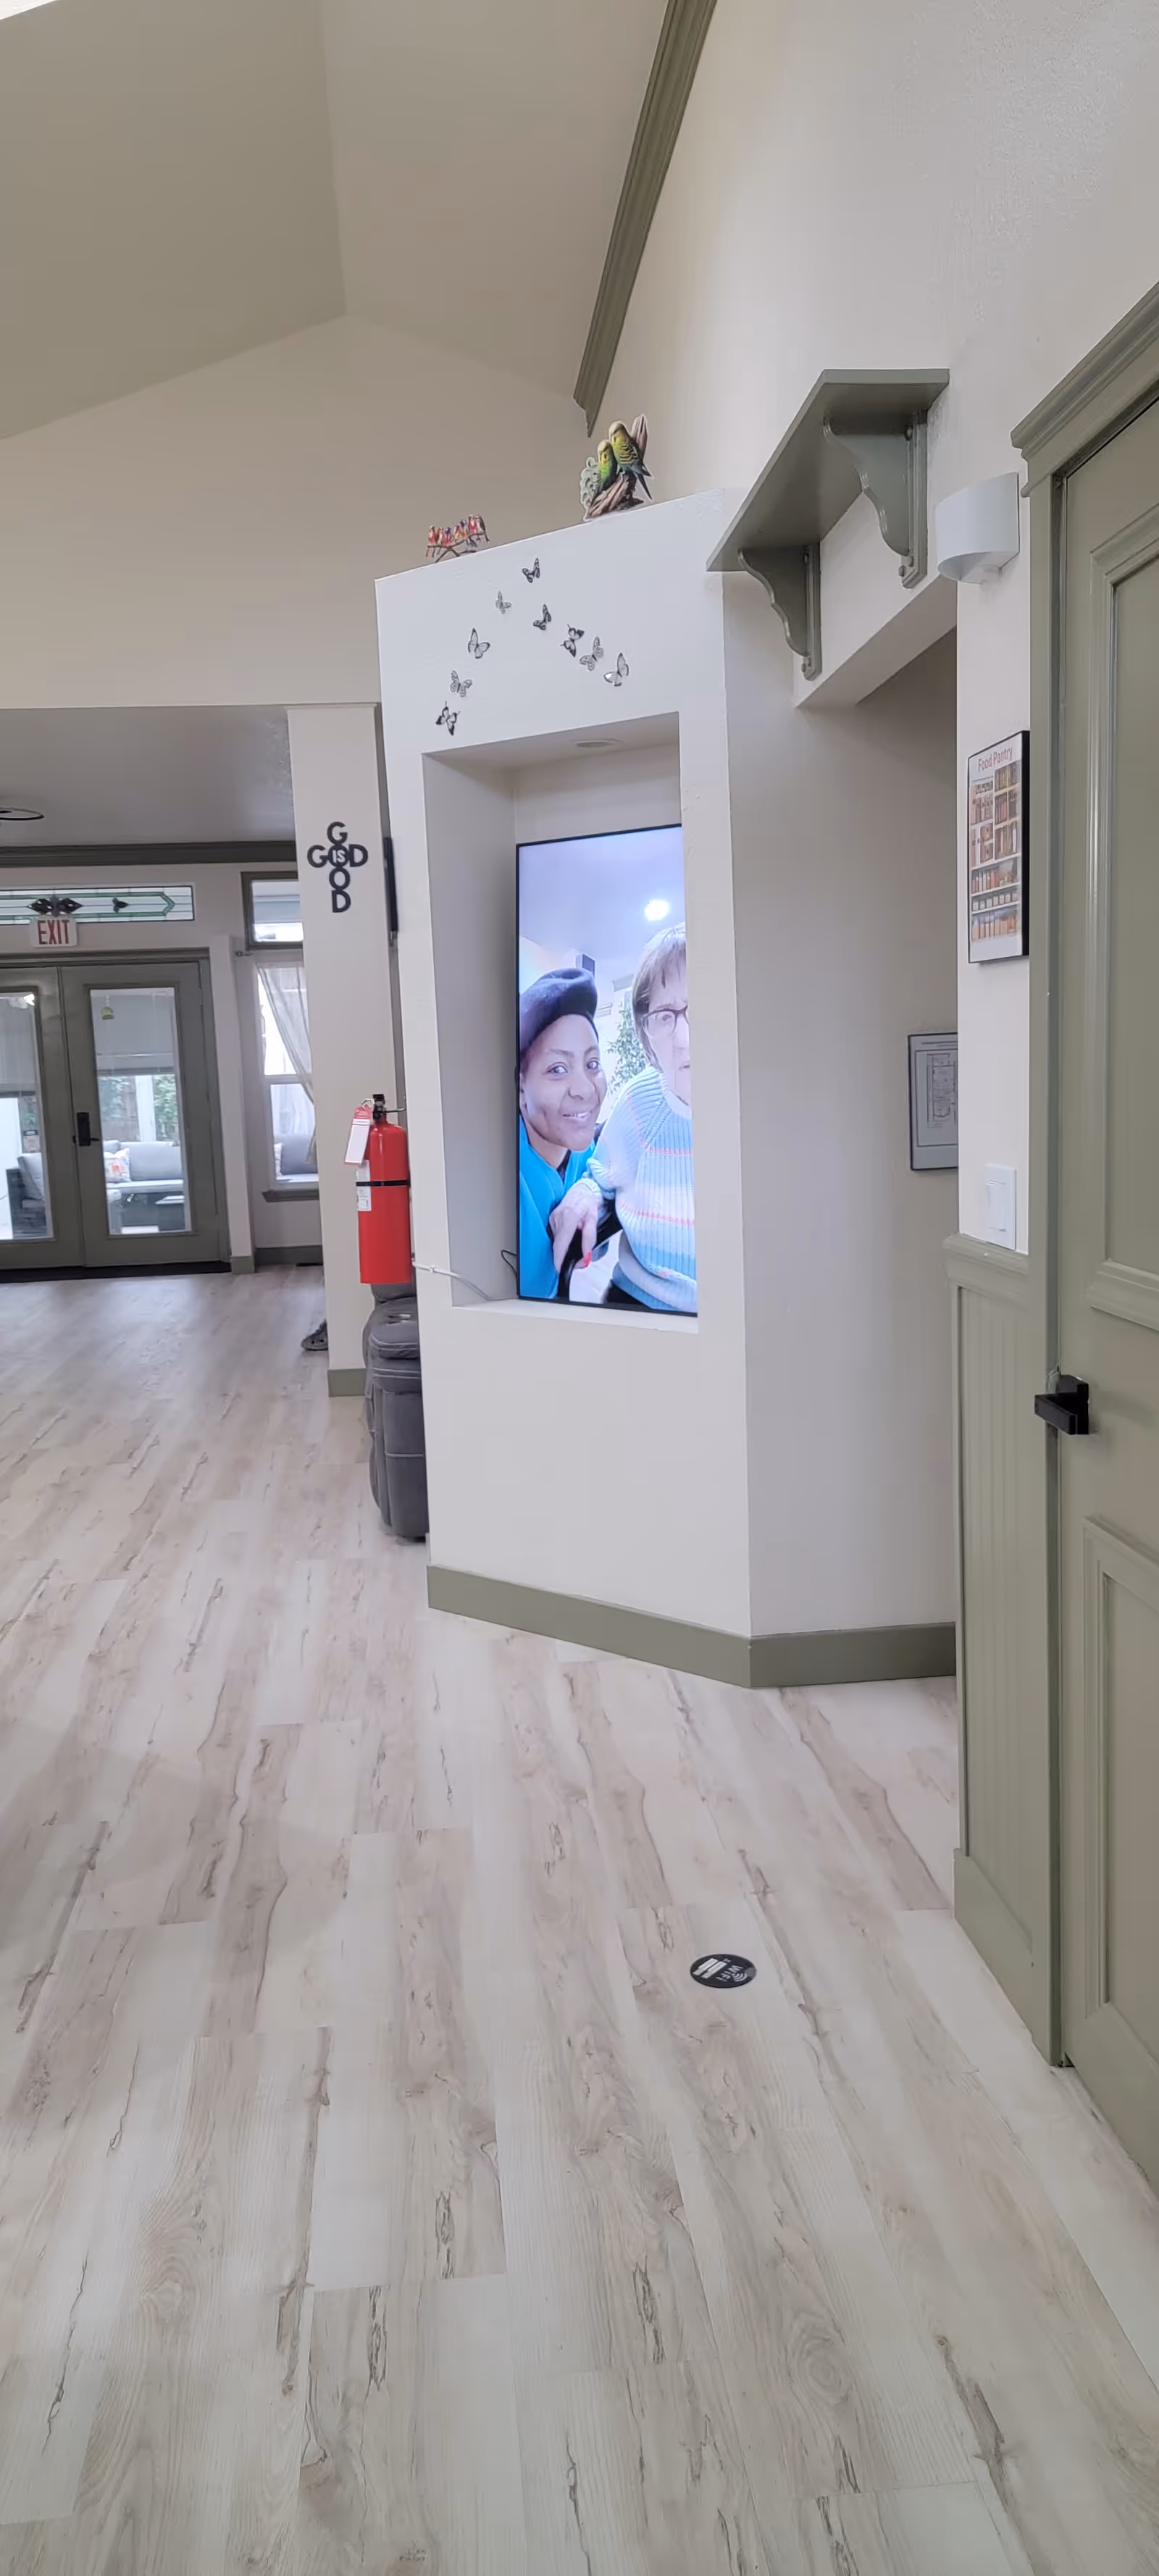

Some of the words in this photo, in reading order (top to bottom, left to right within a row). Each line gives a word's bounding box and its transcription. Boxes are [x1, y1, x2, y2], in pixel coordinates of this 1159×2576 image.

[978, 754, 992, 772] Food
[993, 748, 1013, 766] Pantry
[307, 844, 369, 868] GOD
[332, 850, 346, 863] IS
[38, 919, 70, 945] EXIT
